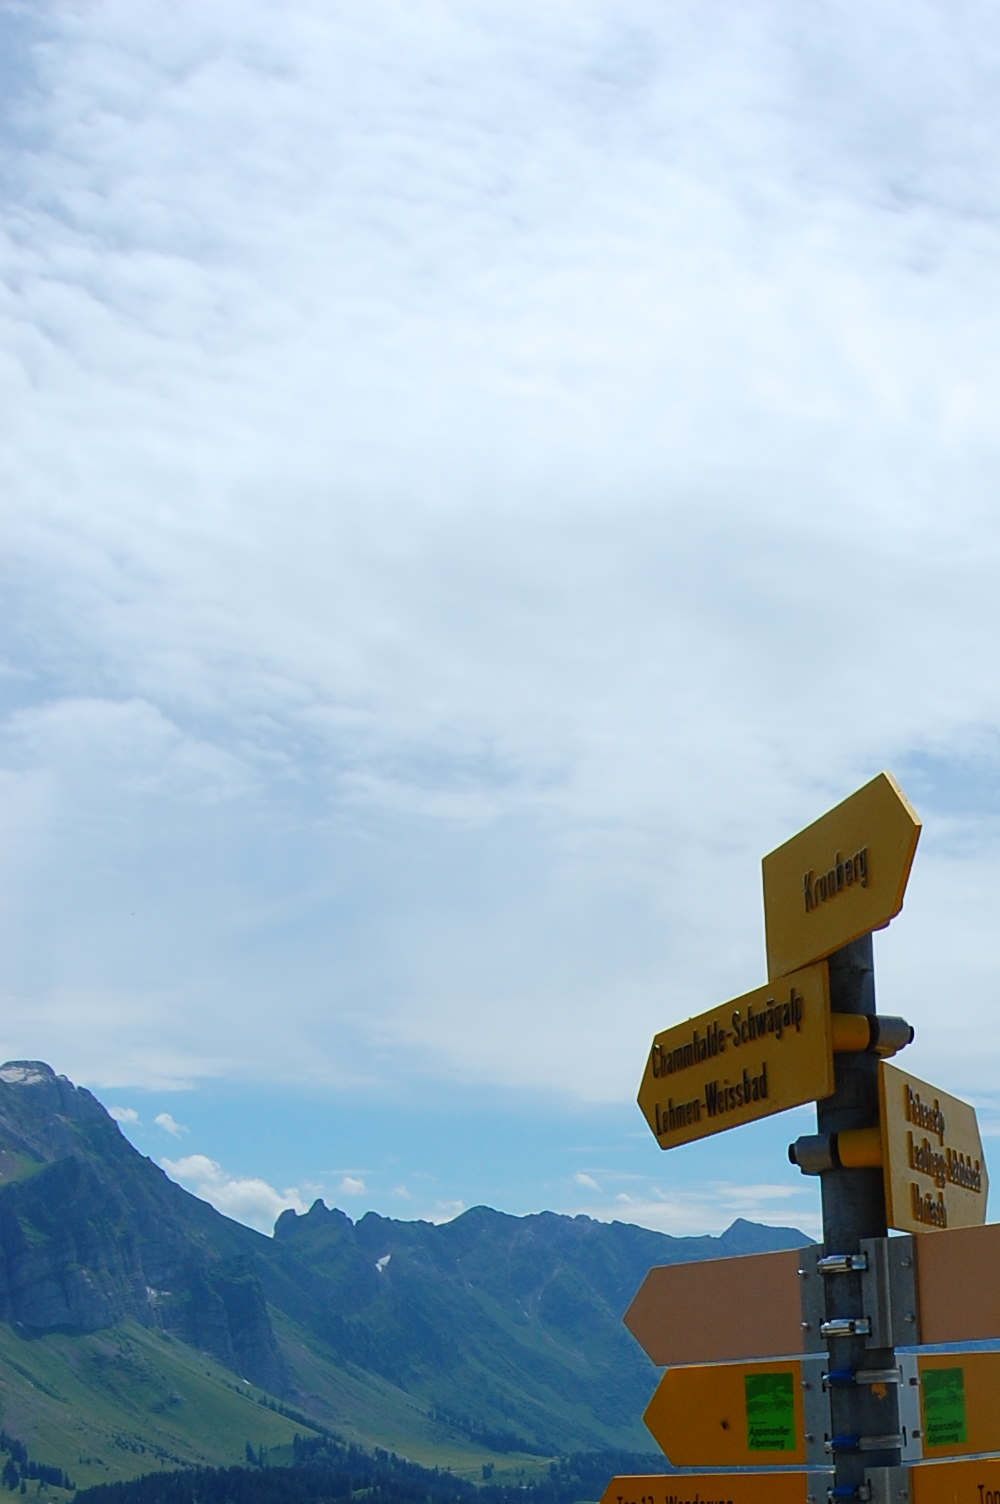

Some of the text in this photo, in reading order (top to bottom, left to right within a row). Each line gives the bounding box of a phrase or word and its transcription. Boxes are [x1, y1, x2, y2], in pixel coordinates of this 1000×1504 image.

[803, 846, 868, 913] Kronberg
[654, 1061, 768, 1136] Lehmen-Weissbad
[748, 1426, 791, 1438] Appenzeller
[926, 1420, 964, 1433] Appenzeller
[748, 1438, 786, 1450] Alpenweg
[926, 1433, 960, 1446] Alpenweg
